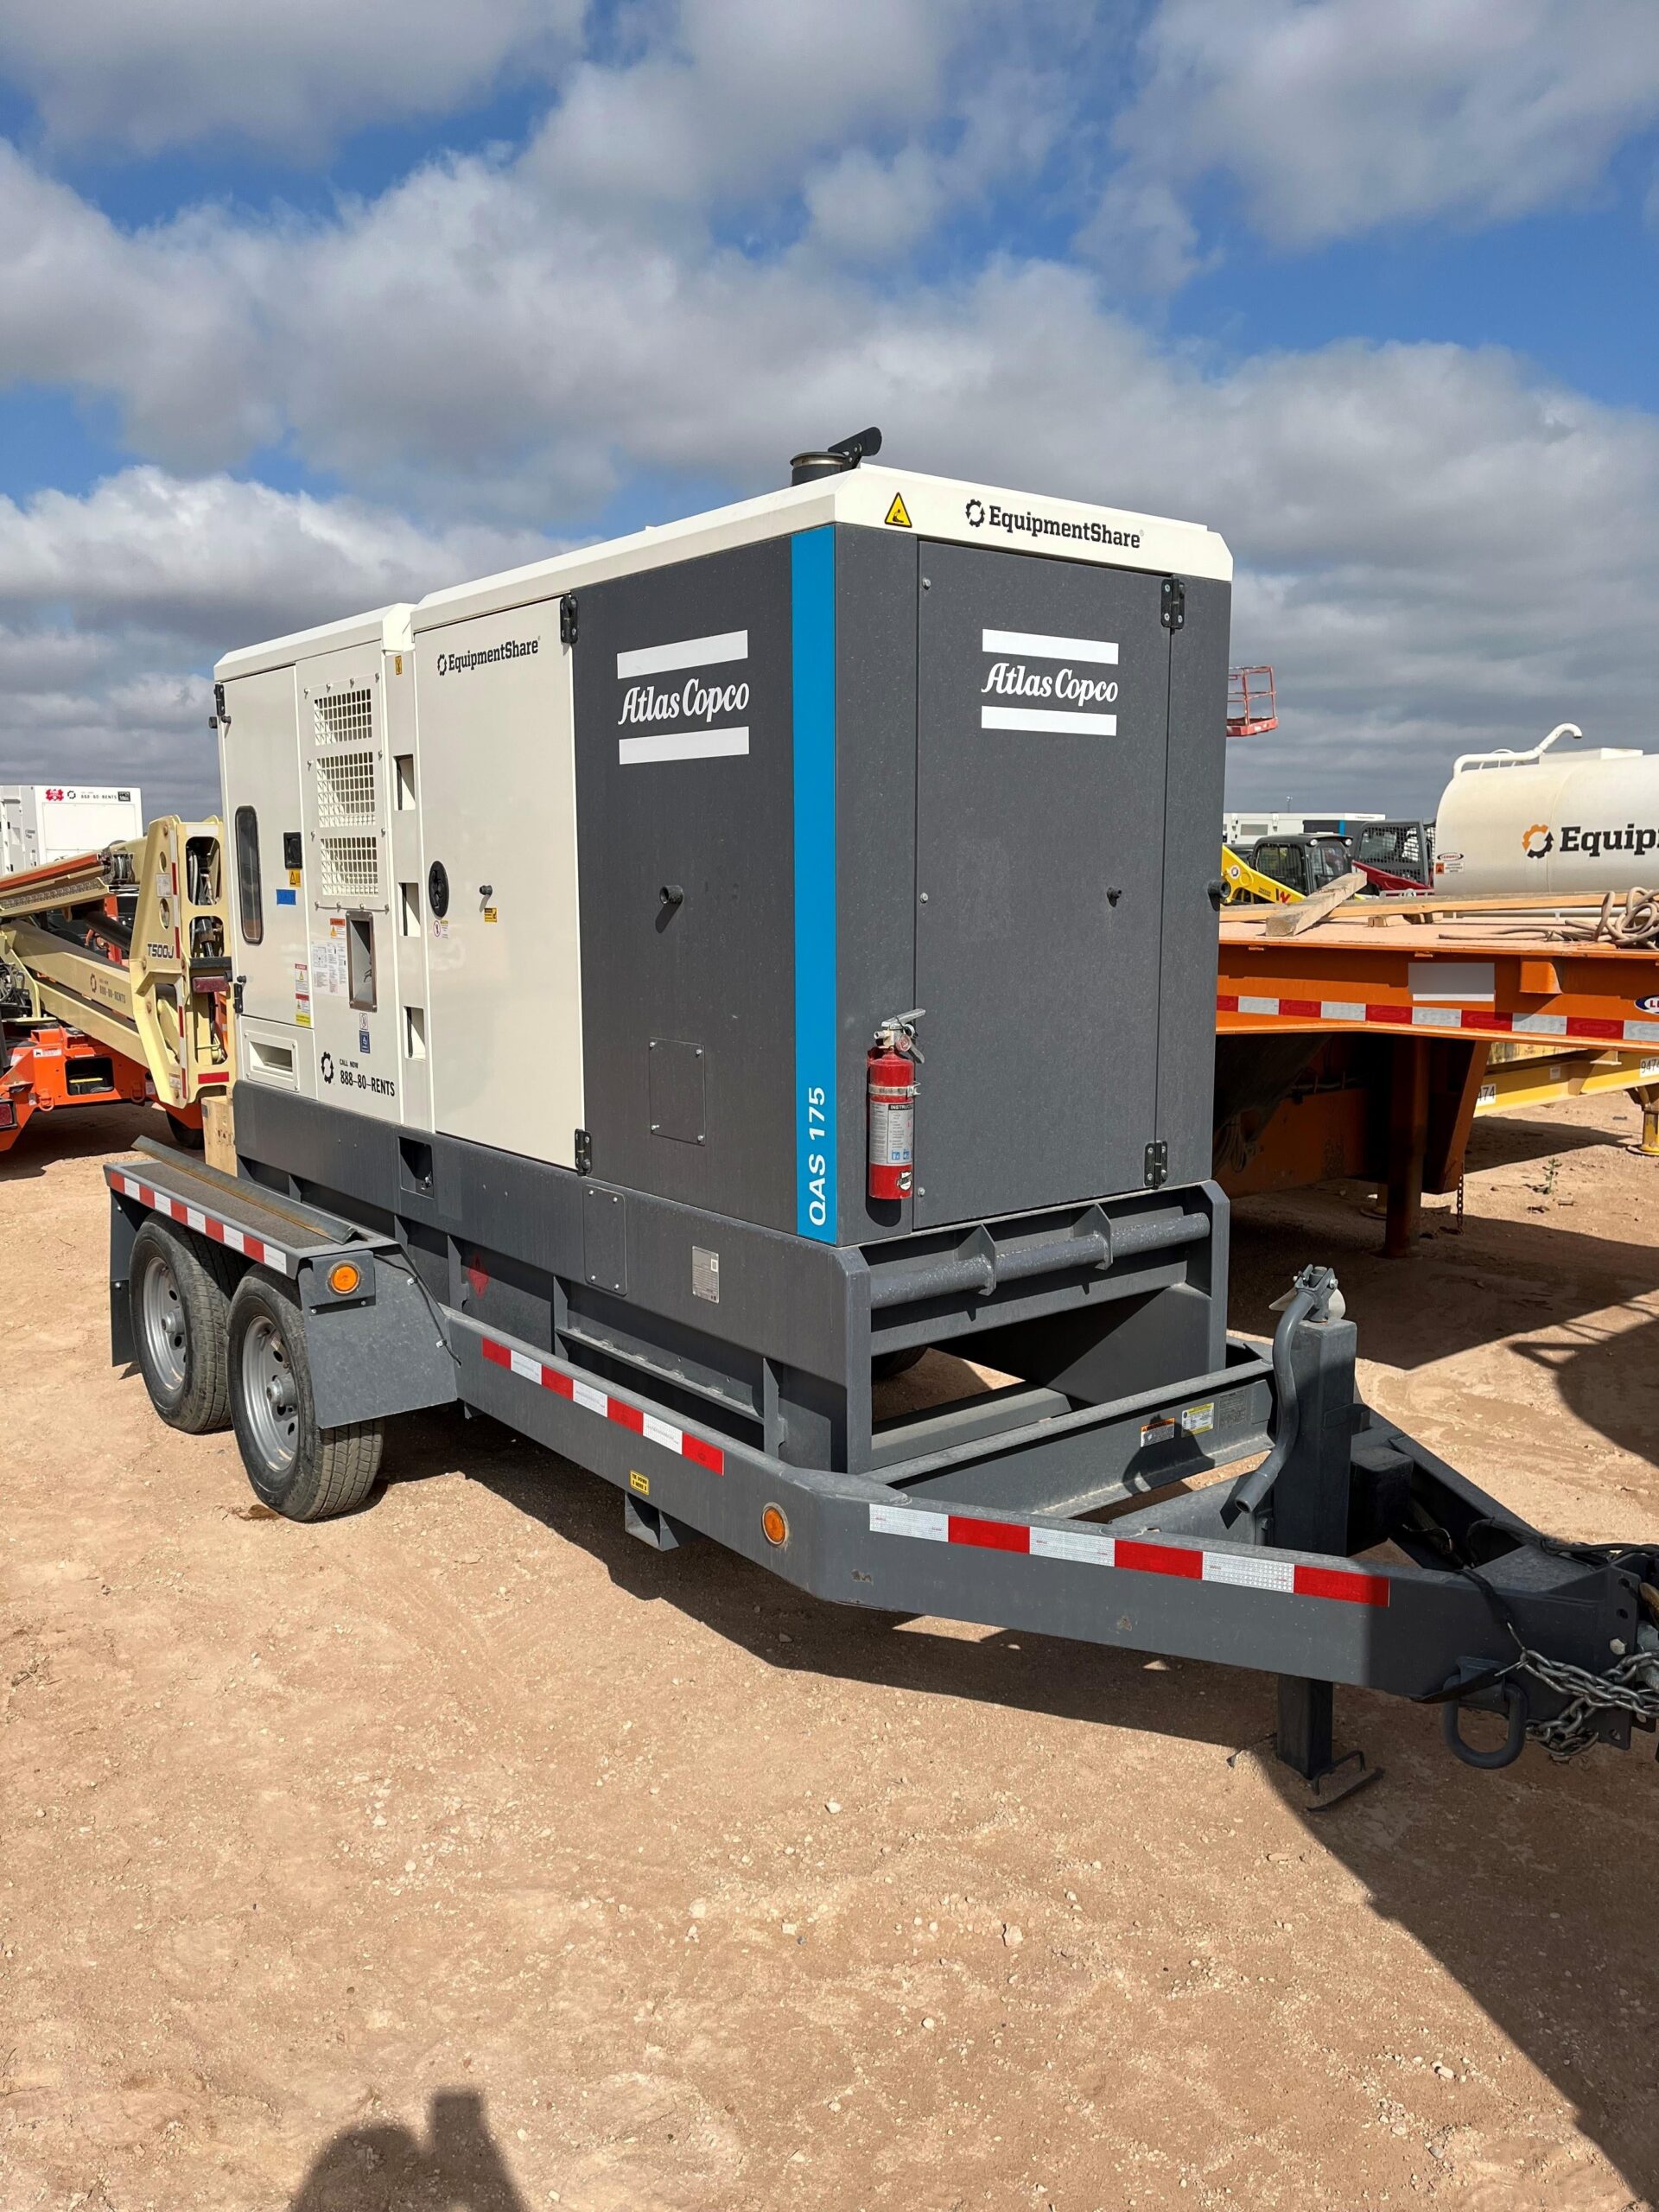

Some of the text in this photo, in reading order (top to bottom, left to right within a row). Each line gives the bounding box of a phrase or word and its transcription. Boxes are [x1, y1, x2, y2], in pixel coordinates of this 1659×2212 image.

[988, 505, 1141, 549] EquipmentShare
[448, 639, 539, 673] EquipmentShare
[981, 662, 1119, 707] Atlas Copco
[617, 678, 750, 726] Atlas Copco
[1559, 823, 1659, 857] Equip
[147, 943, 175, 959] T500J
[339, 1058, 349, 1067] CALL
[340, 1070, 395, 1097] 888-80-RENTS
[808, 1086, 827, 1226] QAS 175
